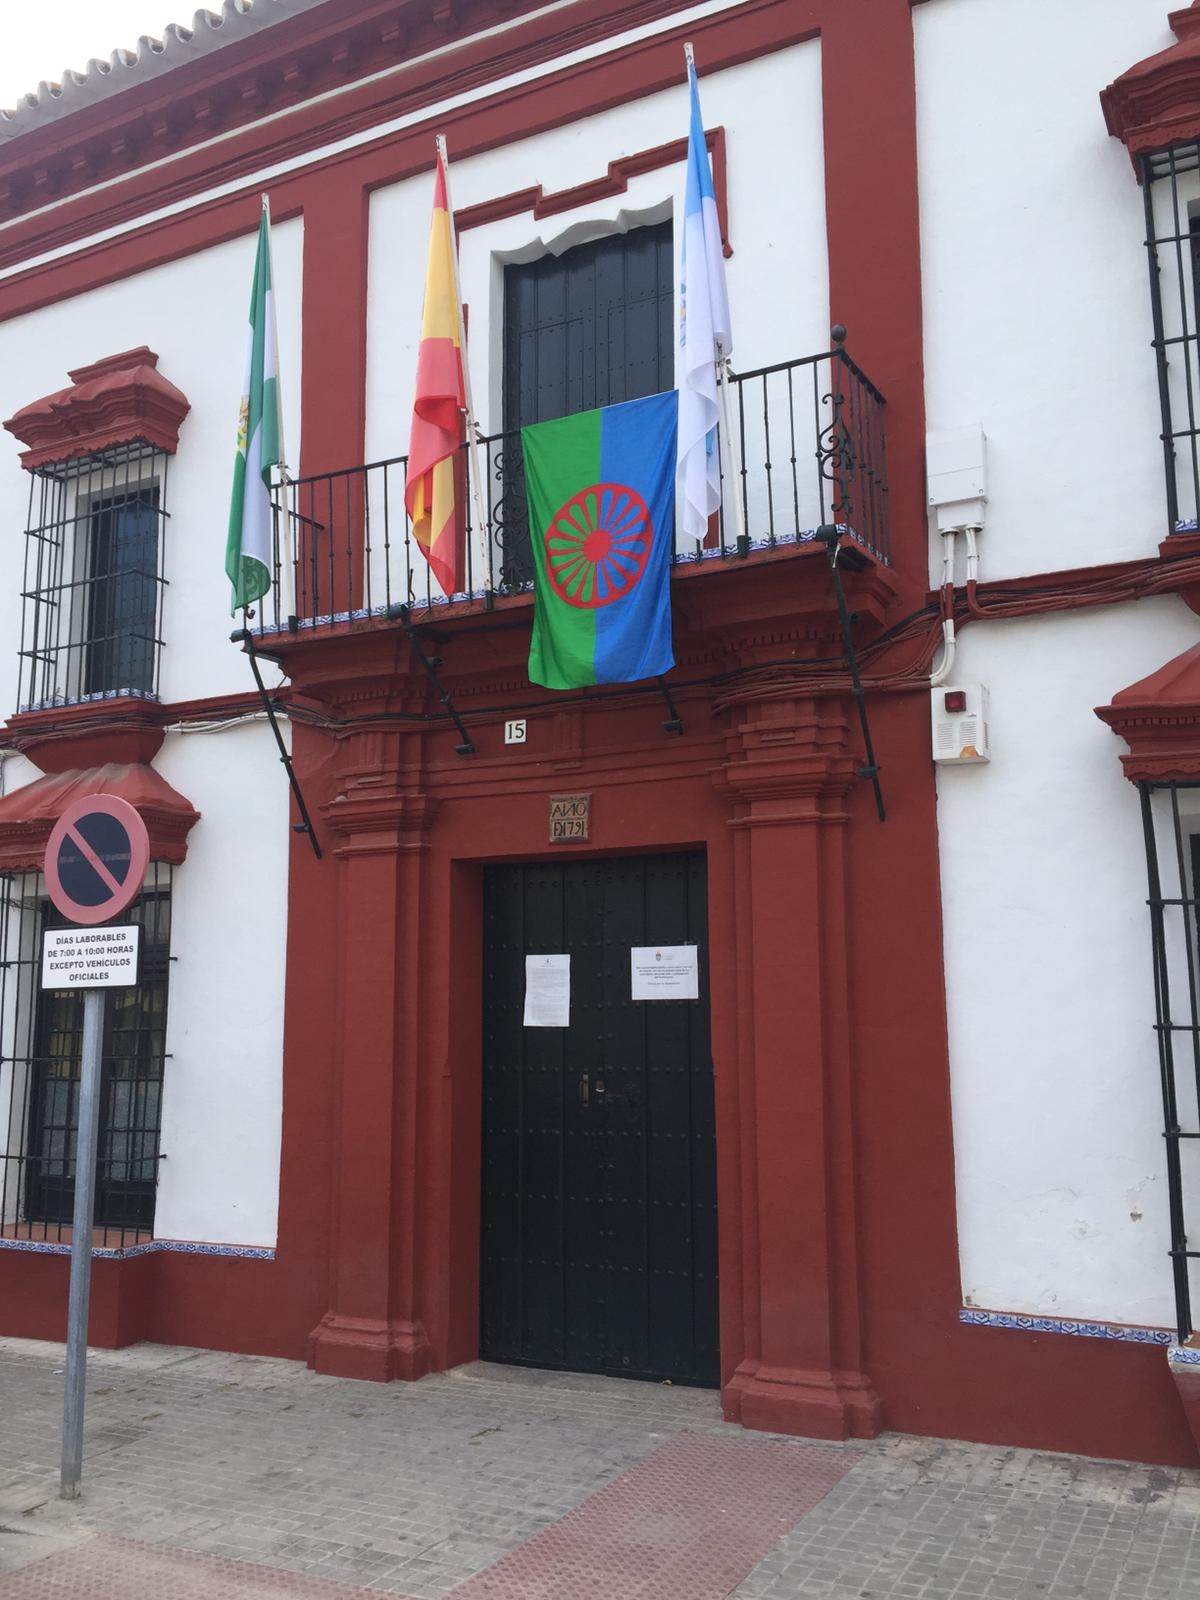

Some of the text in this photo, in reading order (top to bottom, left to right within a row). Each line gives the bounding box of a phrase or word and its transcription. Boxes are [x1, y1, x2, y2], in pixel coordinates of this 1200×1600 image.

[508, 723, 524, 739] 15
[56, 933, 126, 945] DÍAS LABORABLES
[47, 945, 134, 958] DE 7:00 A 10:00 HORAS
[50, 961, 84, 969] EXCEPTO
[69, 972, 110, 982] OFICIALES
